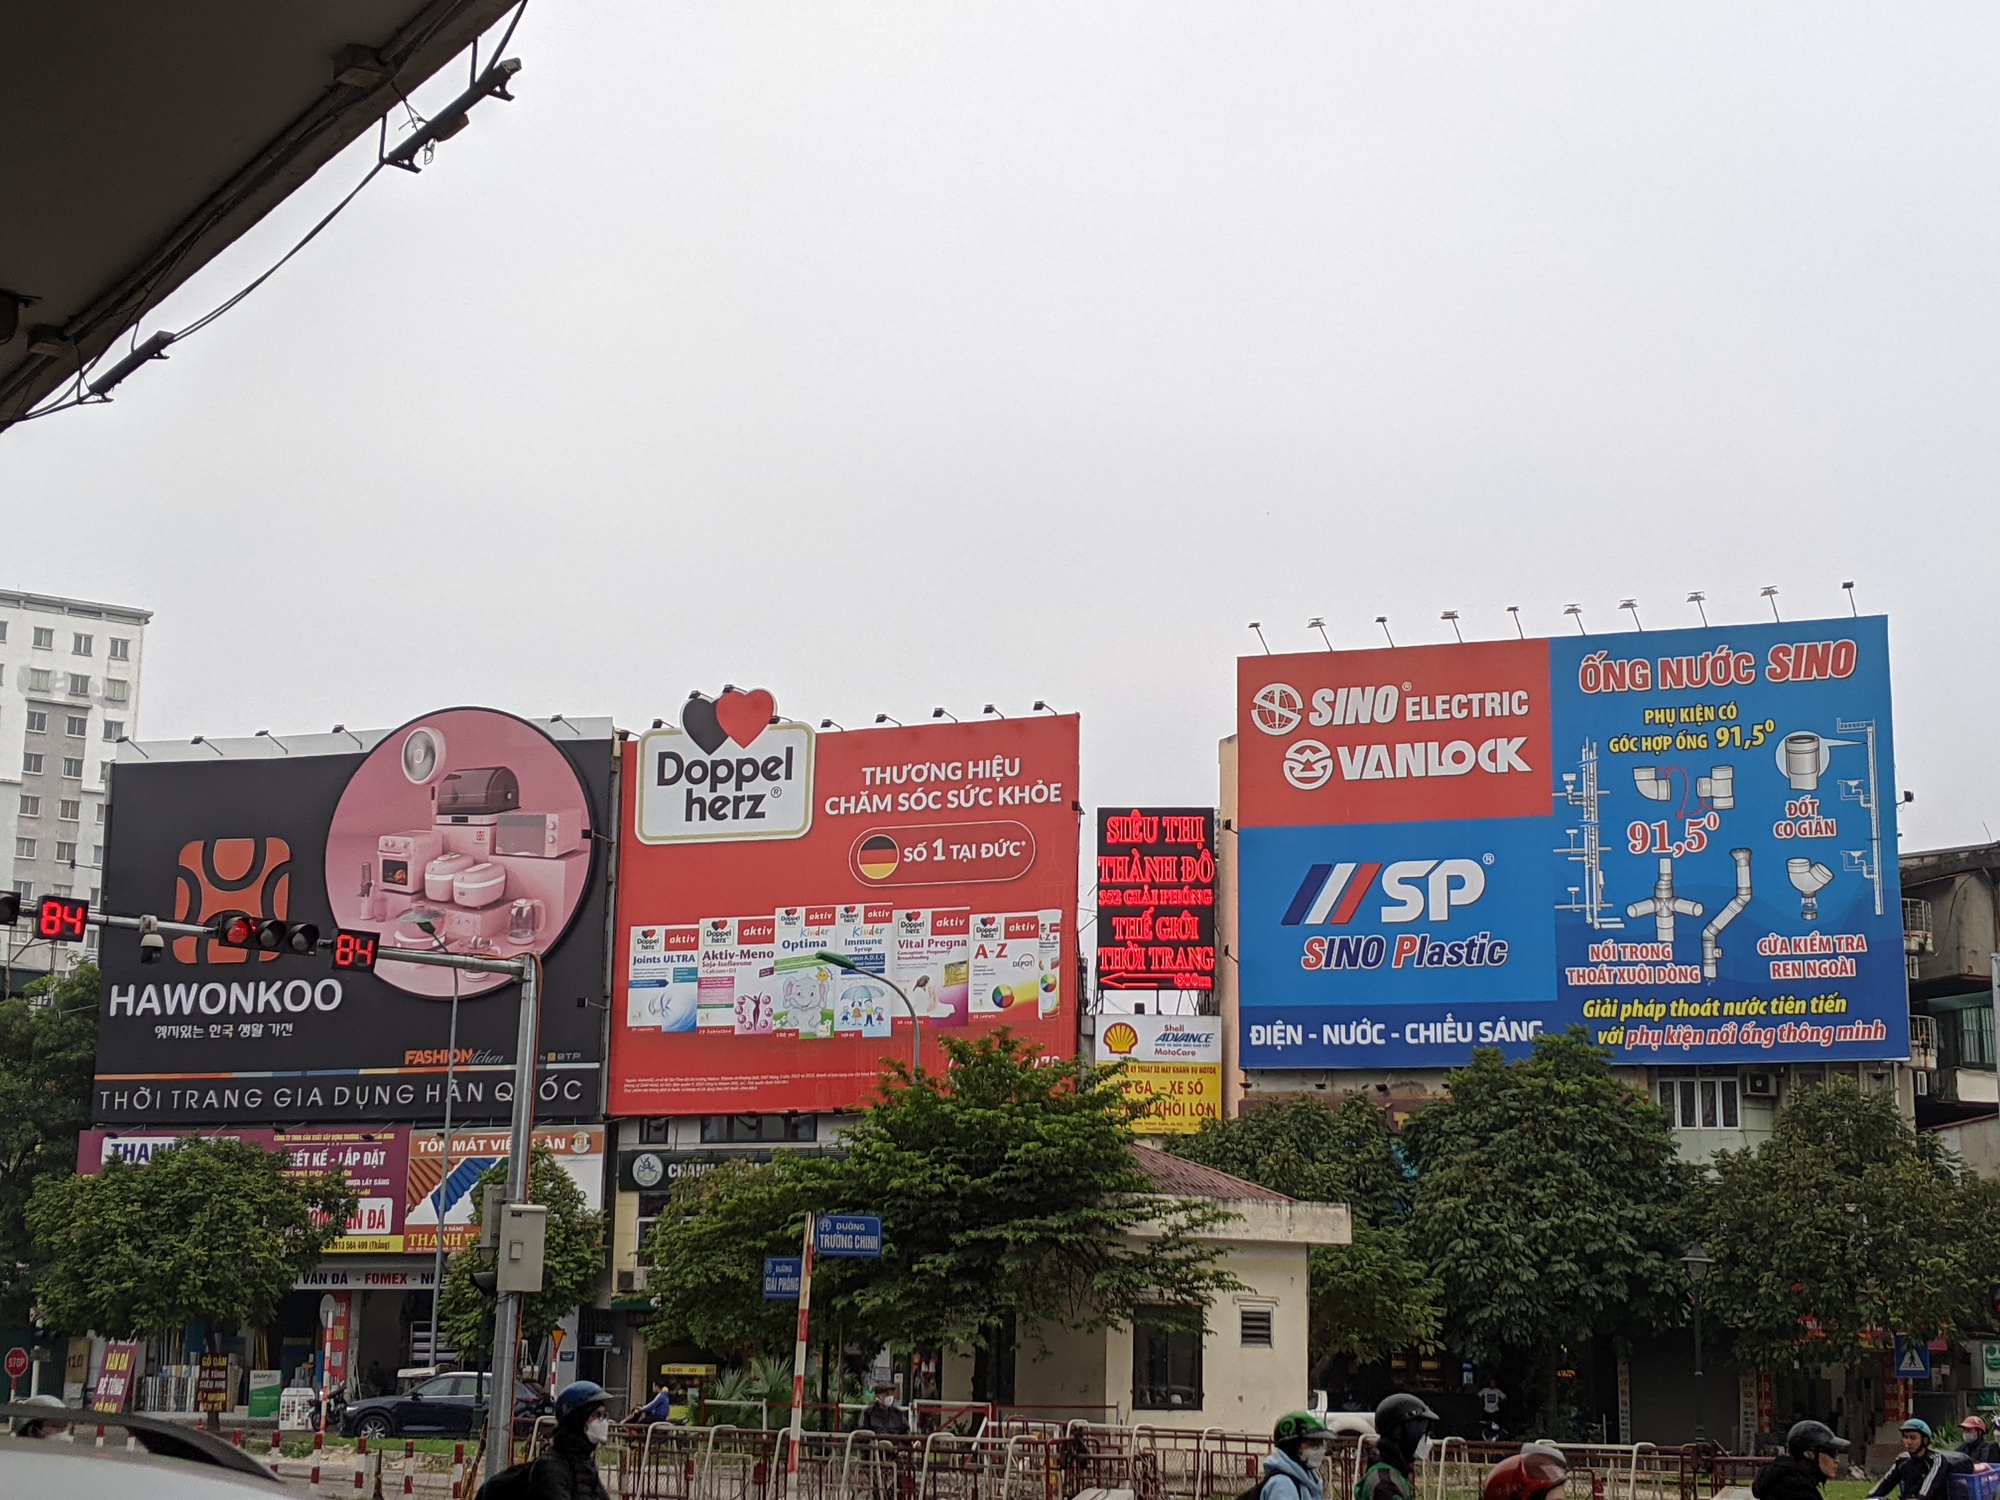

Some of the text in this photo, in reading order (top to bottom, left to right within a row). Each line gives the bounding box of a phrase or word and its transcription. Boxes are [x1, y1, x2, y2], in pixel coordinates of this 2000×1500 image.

[1580, 640, 1857, 694] ỐNG NƯỚC SINO
[1406, 690, 1529, 723] ELECTRIC
[1644, 701, 1737, 728] PHỤ KIỆN CÓ
[1609, 730, 1708, 755] GÓC HỢP ỐNG
[1337, 737, 1532, 780] VANLOCK
[657, 746, 793, 793] Doppel
[862, 754, 1020, 786] THƯƠNG HIỆU
[824, 780, 1062, 815] CHĂM SÓC SỨC KHỎE
[1787, 796, 1819, 819] ĐỐT
[1106, 809, 1205, 850] SIÊU THỊ
[1773, 816, 1837, 838] CO GIÃN
[903, 841, 927, 862] SỐ
[932, 838, 946, 861] 1
[950, 843, 976, 863] TẠI
[1098, 848, 1215, 883] THÀNH ĐÔ
[1123, 884, 1158, 905] GIẢI
[1160, 885, 1212, 906] PHÓNG
[1381, 859, 1486, 923] SP
[40, 901, 83, 936] 84
[809, 912, 833, 920] aktiv
[867, 910, 890, 918] aktiv
[936, 917, 965, 927] aktiv
[1112, 907, 1154, 940] THẾ
[743, 926, 772, 936] aktiv
[800, 927, 829, 937] Kinder
[852, 925, 885, 937] Kinder
[1009, 922, 1036, 931] aktiv
[669, 935, 696, 943] aktiv
[782, 938, 827, 951] Optima
[844, 938, 883, 946] Immune
[898, 939, 967, 949] Vital Pregna
[1757, 930, 1868, 956] CỬA KIỂM TRA
[335, 934, 374, 966] 84
[633, 954, 696, 966] Joints ULTRA
[702, 949, 774, 961] Aktiv-Meno
[974, 943, 1008, 959] A-Z
[1098, 941, 1215, 971] THỜI TRANG
[1301, 931, 1508, 970] SINO Plastic
[1589, 940, 1673, 961] NỐI TRONG
[1565, 964, 1701, 985] THOÁT XUÔI DÒNG
[1770, 959, 1856, 980] REN NGOÀI
[109, 978, 343, 1016] HAWONKOO
[1583, 991, 1847, 1022] Giải pháp thoát nước tiên tiến
[1155, 1032, 1214, 1043] ADVANCE
[1164, 1024, 1184, 1032] Shell
[1250, 1020, 1302, 1050] ĐIỆN
[1323, 1018, 1386, 1045] NƯỚC
[1479, 1015, 1543, 1043] SÁNG
[1598, 1020, 1886, 1050] với phụ kiện nối ống thông minh
[404, 1048, 473, 1064] FASHION
[1154, 1048, 1196, 1056] MotoCare
[100, 1086, 160, 1110] THỜI
[171, 1088, 264, 1109] TRANG
[273, 1086, 324, 1108] GIA
[333, 1084, 415, 1110] DỤNG
[495, 1074, 582, 1102] QỐC
[1135, 1080, 1153, 1094] GA
[1169, 1081, 1184, 1095] XE
[1188, 1078, 1203, 1095] SỐ
[452, 1137, 487, 1151] MÁT
[312, 1148, 329, 1167] KẾ
[363, 1148, 386, 1169] ĐẶT
[367, 1204, 385, 1229] ĐÁ
[836, 1222, 865, 1231] ĐƯỜNG
[820, 1231, 878, 1249] TRƯỜNG CHINH
[364, 1273, 408, 1284] FOMEX
[8, 1358, 25, 1368] STOP
